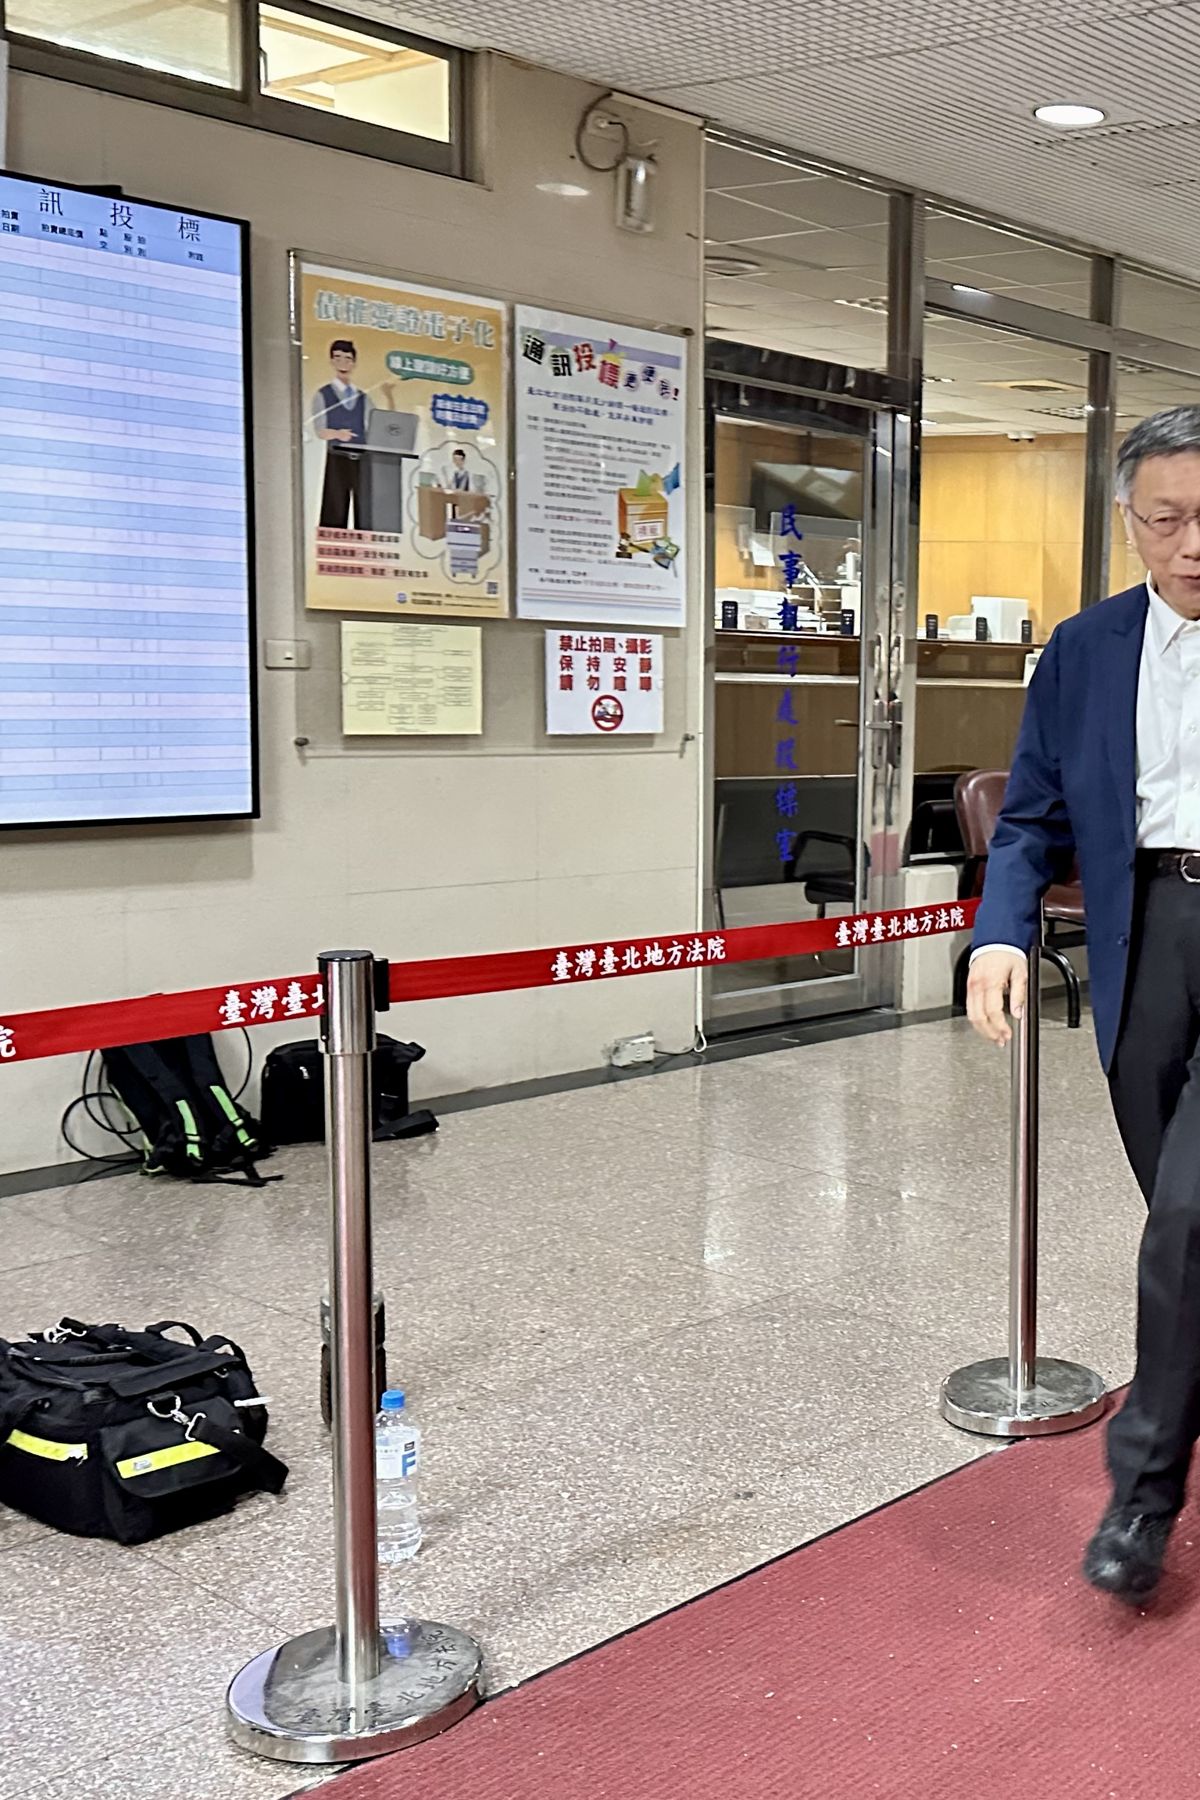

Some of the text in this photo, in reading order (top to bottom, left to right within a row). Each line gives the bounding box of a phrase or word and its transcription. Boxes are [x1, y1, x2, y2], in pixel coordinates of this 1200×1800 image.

[559, 635, 653, 655] 禁止拍照、攝影
[559, 655, 653, 674] 保持安靜
[834, 905, 966, 947] 臺灣臺北地方法院
[550, 935, 727, 982] 臺灣臺北地方法院
